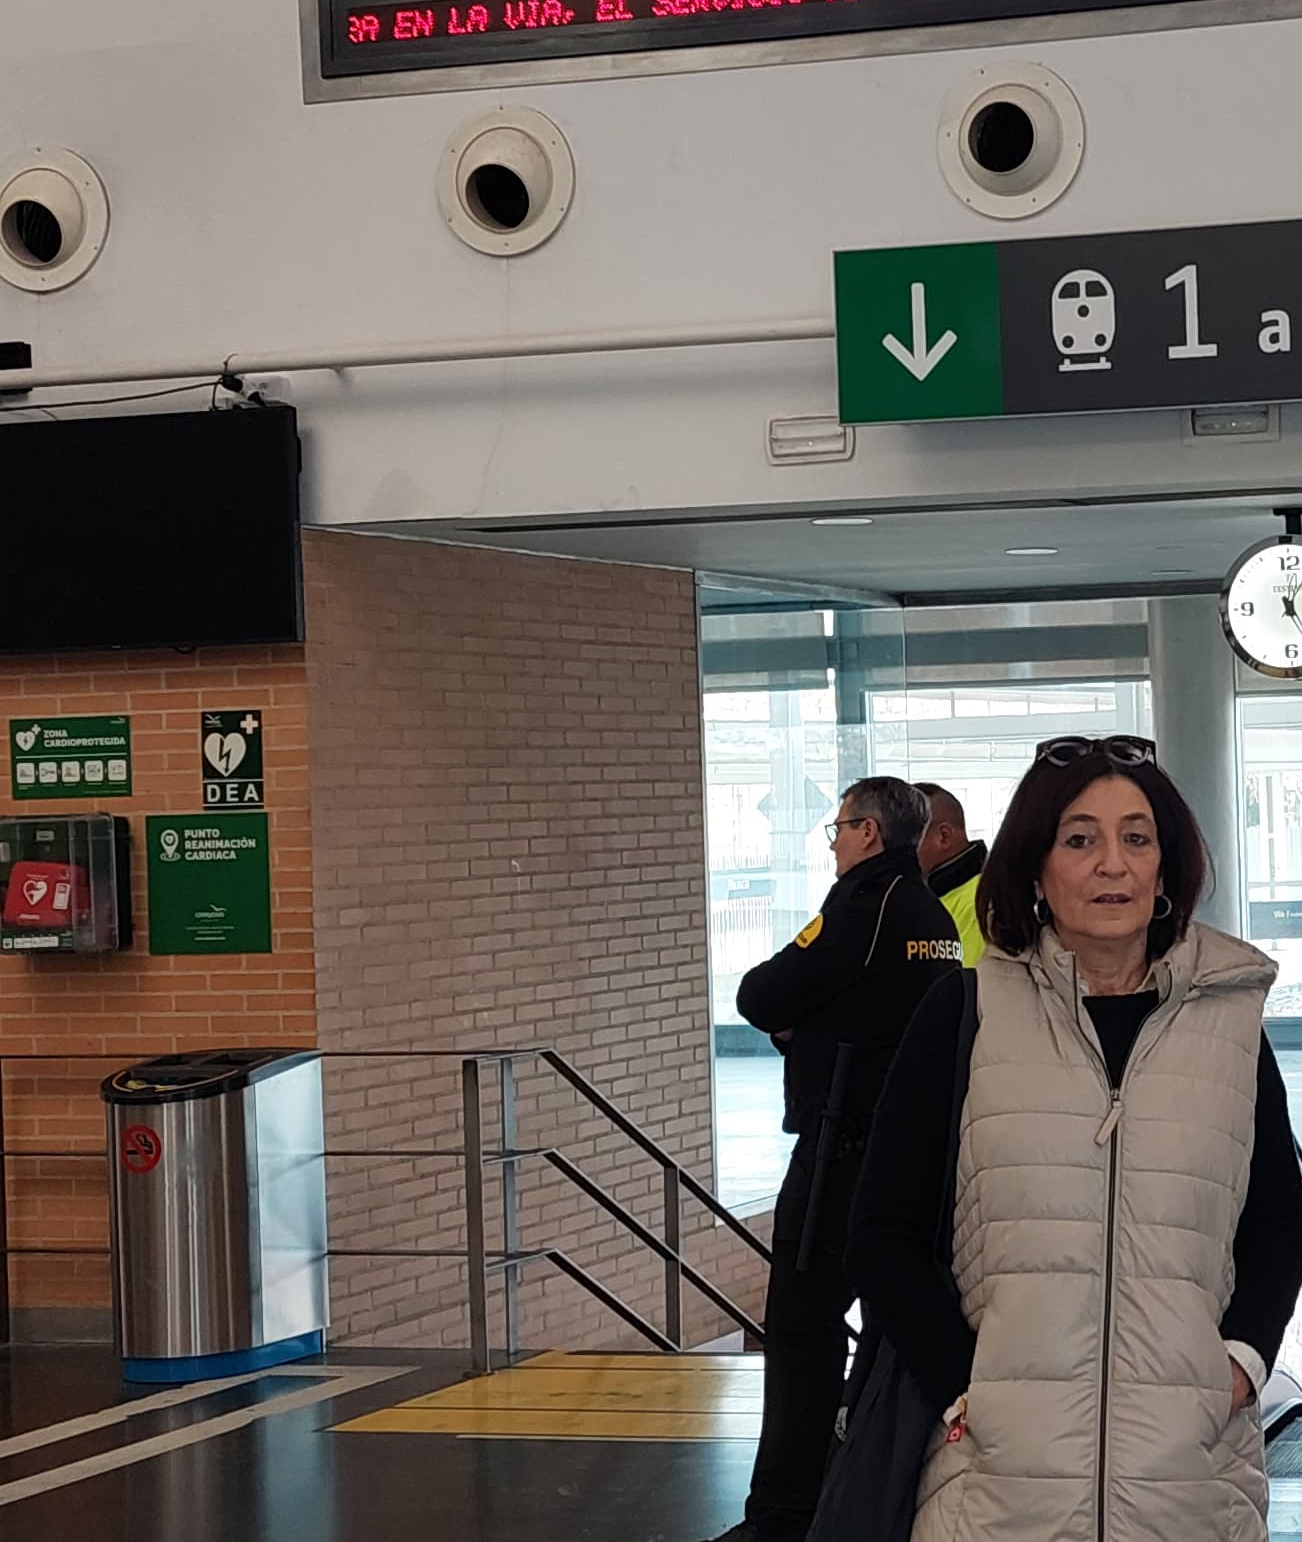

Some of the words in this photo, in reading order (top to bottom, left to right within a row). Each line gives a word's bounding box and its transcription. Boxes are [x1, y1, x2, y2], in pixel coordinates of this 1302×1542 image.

[393, 9, 435, 40] EN
[447, 3, 490, 35] LA
[1164, 263, 1219, 361] 1
[1258, 309, 1292, 354] a
[1276, 555, 1301, 571] 12
[1241, 602, 1254, 616] 9
[1285, 644, 1299, 658] 6
[43, 729, 68, 739] ZONA
[206, 783, 260, 803] DEA
[184, 828, 221, 839] PUNTO
[907, 939, 962, 961] PROSEG
